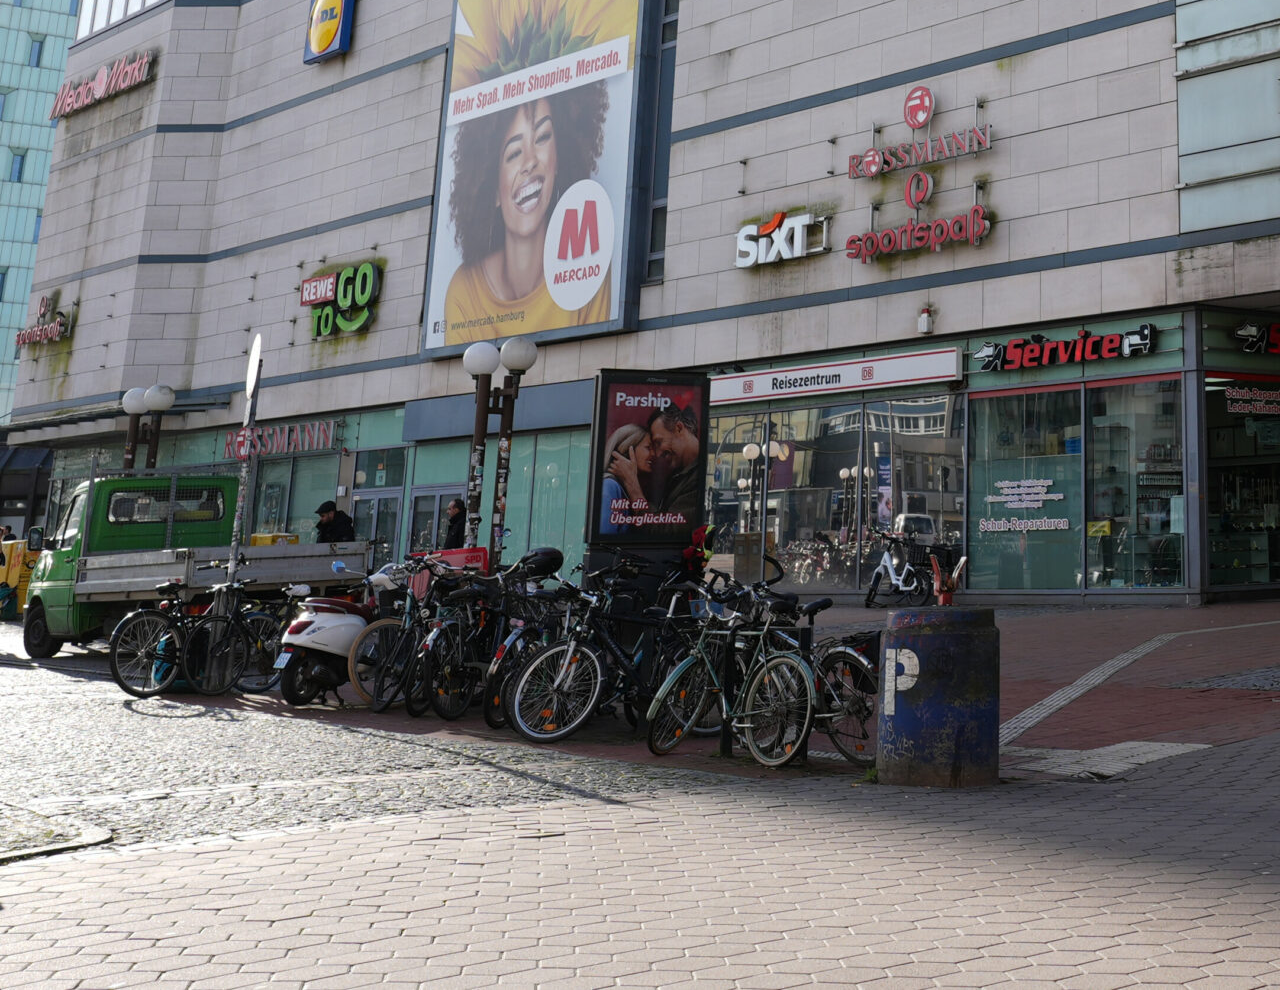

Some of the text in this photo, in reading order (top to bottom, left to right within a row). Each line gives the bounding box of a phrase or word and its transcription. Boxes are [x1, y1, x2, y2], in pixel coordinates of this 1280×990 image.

[100, 52, 150, 98] Markt
[452, 49, 622, 116] Mehr Spaß. Mehr Shopping. Mercado.
[848, 124, 992, 179] ROSSMANN
[845, 204, 991, 264] sportspaß
[337, 262, 374, 308] GO
[553, 264, 601, 285] MERCADO
[302, 277, 334, 302] REWE
[311, 305, 334, 338] TO
[450, 310, 525, 330] www.mercado.hamburg
[1004, 330, 1121, 370] Service
[771, 372, 841, 391] Reisezentrum
[615, 392, 671, 412] Parship
[610, 498, 649, 510] Mit dir.
[610, 512, 687, 526] Überglücklich.
[980, 517, 1069, 533] Schuh-Reparaturen
[465, 554, 482, 564] SPD
[884, 648, 920, 716] P
